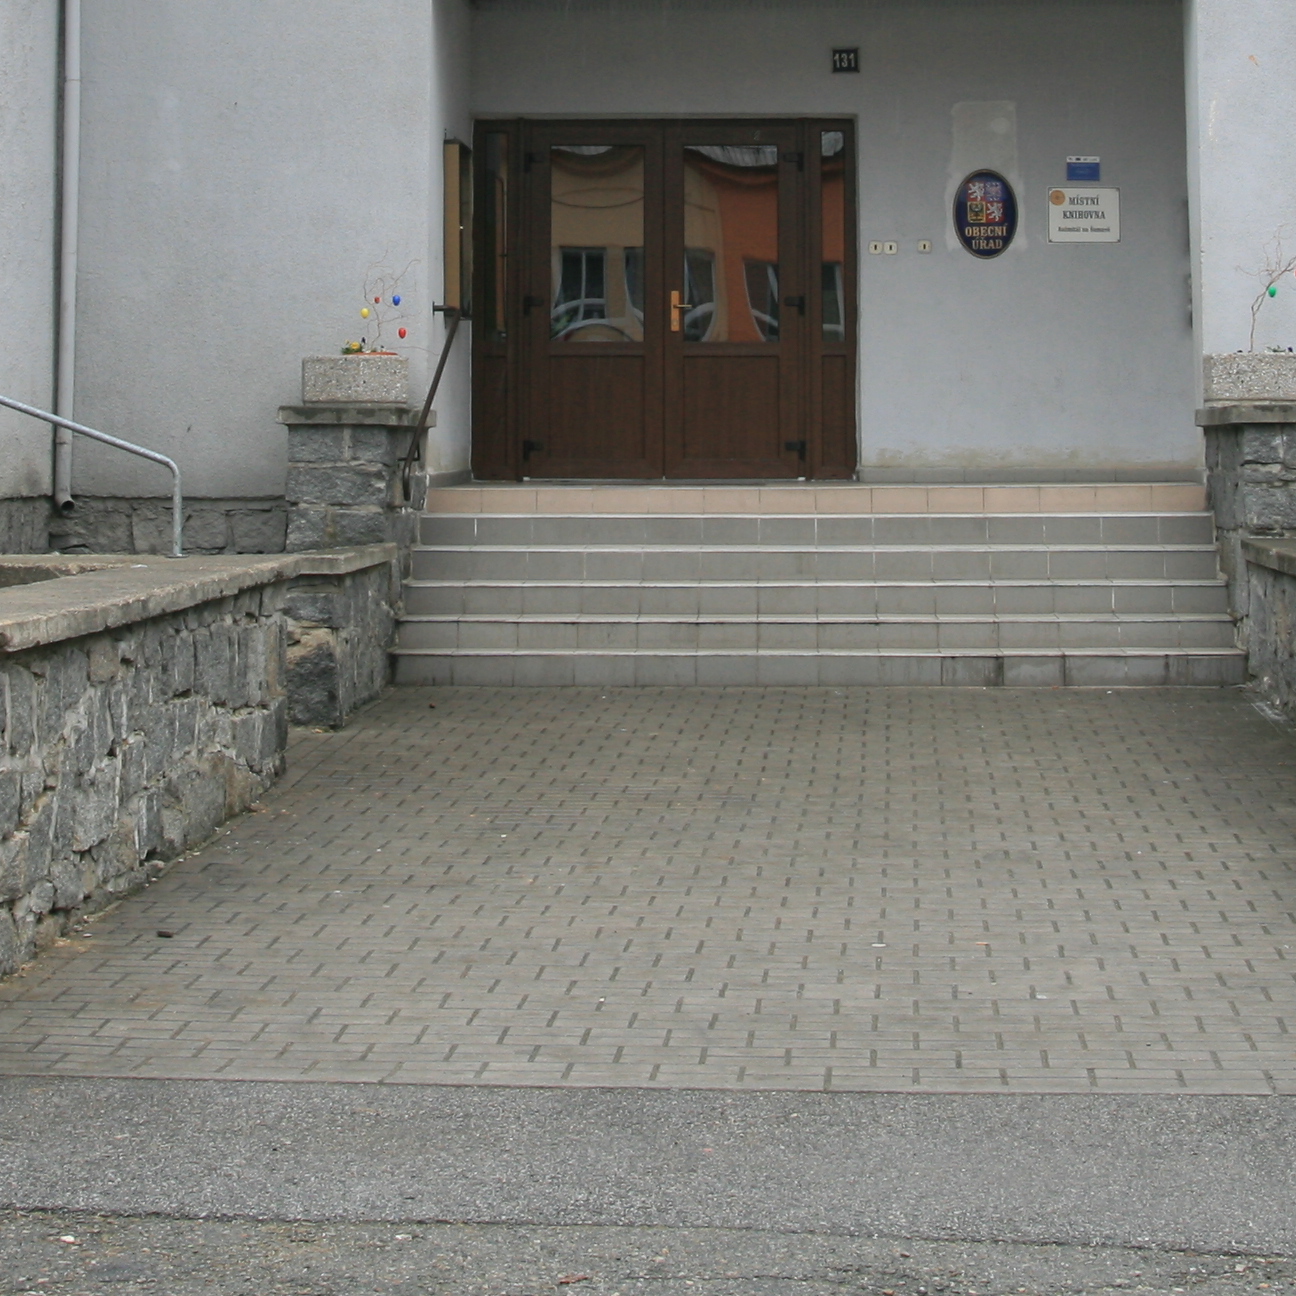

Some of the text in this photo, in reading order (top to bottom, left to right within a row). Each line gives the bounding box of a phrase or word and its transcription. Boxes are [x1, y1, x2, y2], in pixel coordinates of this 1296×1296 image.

[834, 53, 855, 68] 131
[1068, 194, 1100, 205] MÍSTNÍ
[1062, 210, 1106, 219] KNIHOVNA
[965, 223, 1008, 237] OBECNÍ
[972, 236, 1003, 250] ÚŘAD
